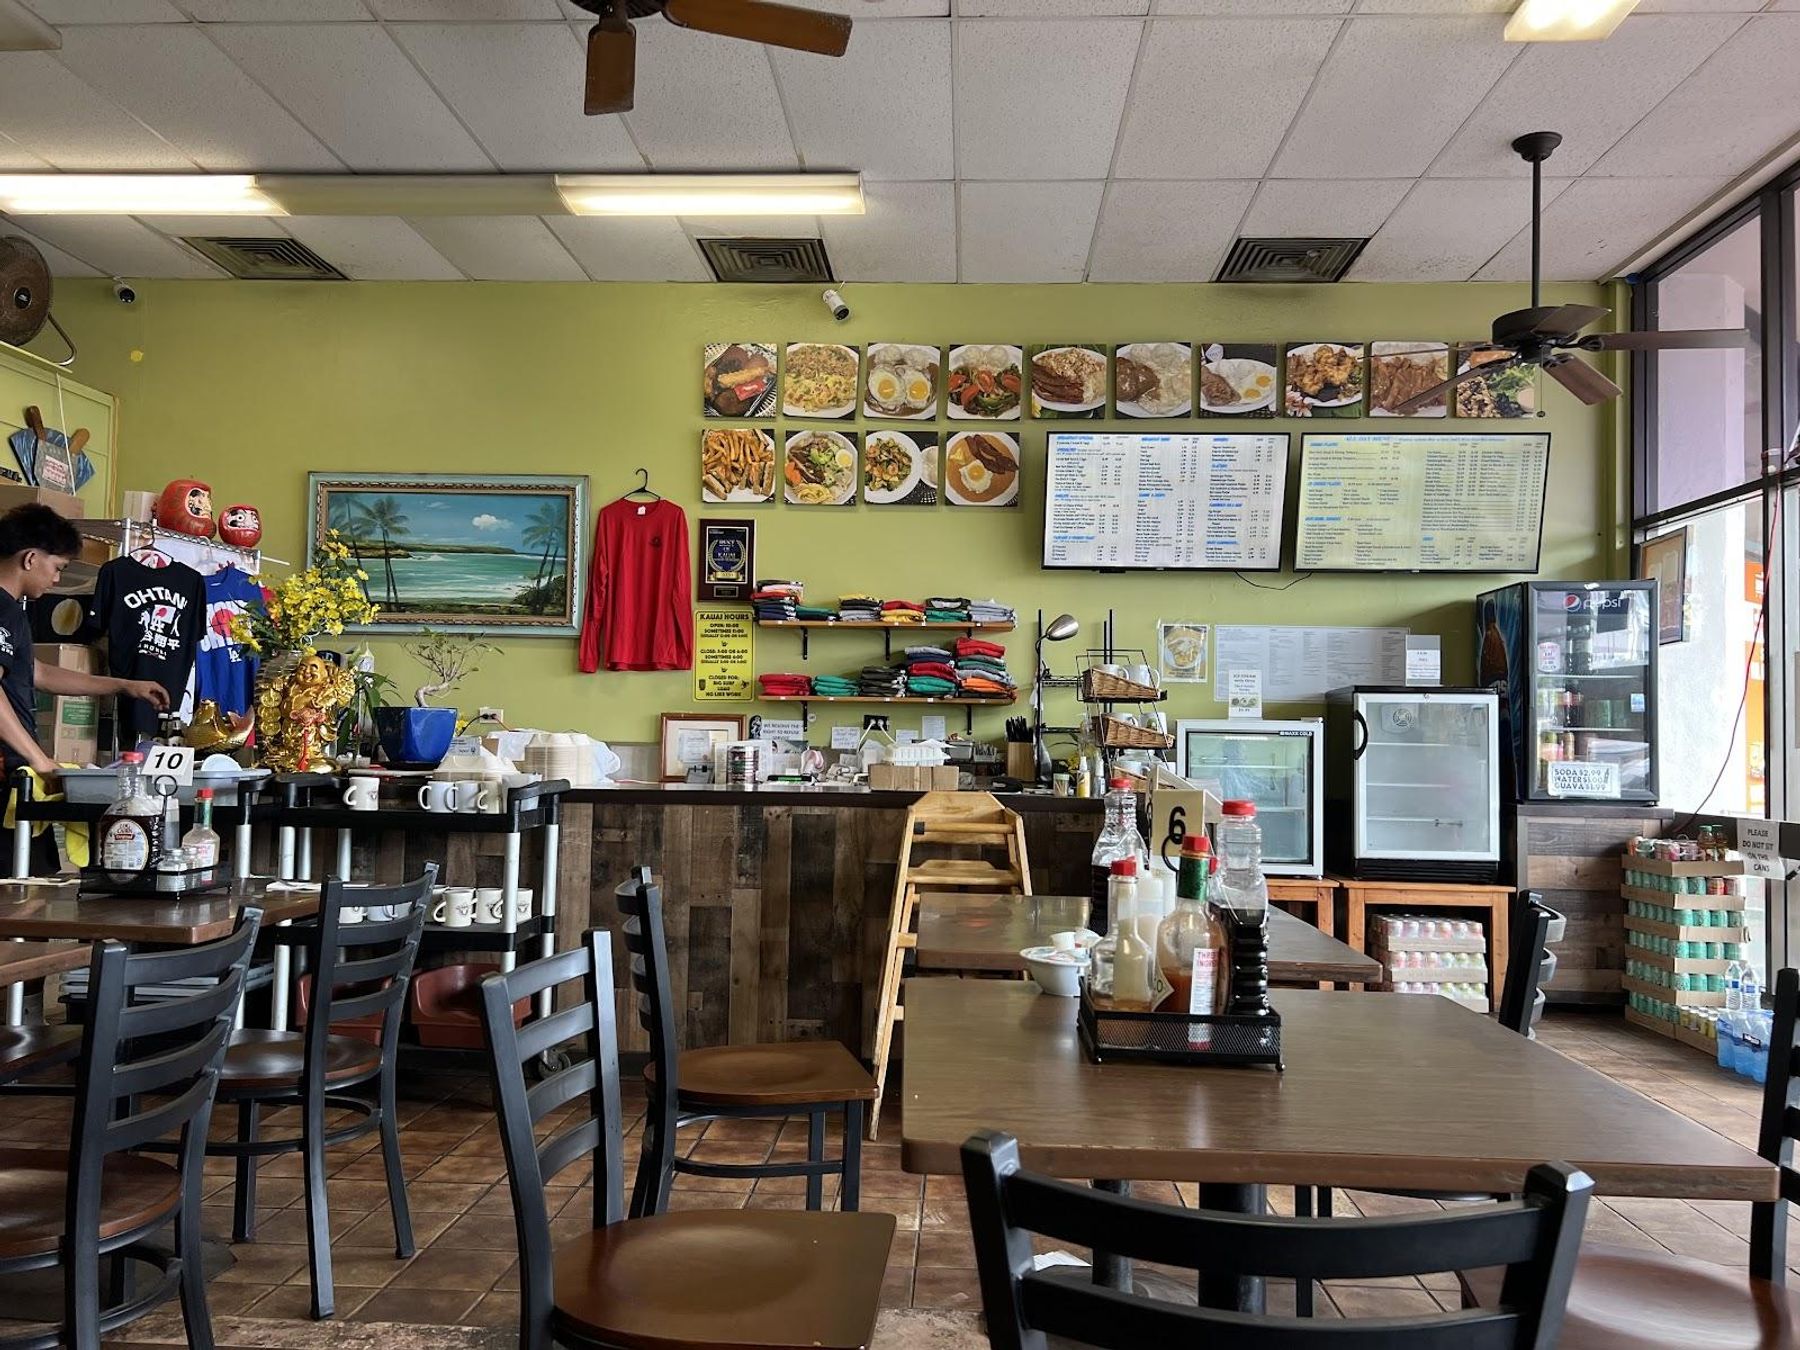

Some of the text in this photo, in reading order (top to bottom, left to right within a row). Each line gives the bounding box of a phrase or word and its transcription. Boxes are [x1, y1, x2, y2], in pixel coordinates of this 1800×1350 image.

[154, 752, 184, 770] 10
[1554, 782, 1584, 790] GUAVA
[1168, 806, 1187, 844] 6
[1748, 829, 1769, 837] PLEASE
[1752, 841, 1764, 849] NOT
[1757, 853, 1769, 861] THE
[1753, 864, 1770, 872] CANS
